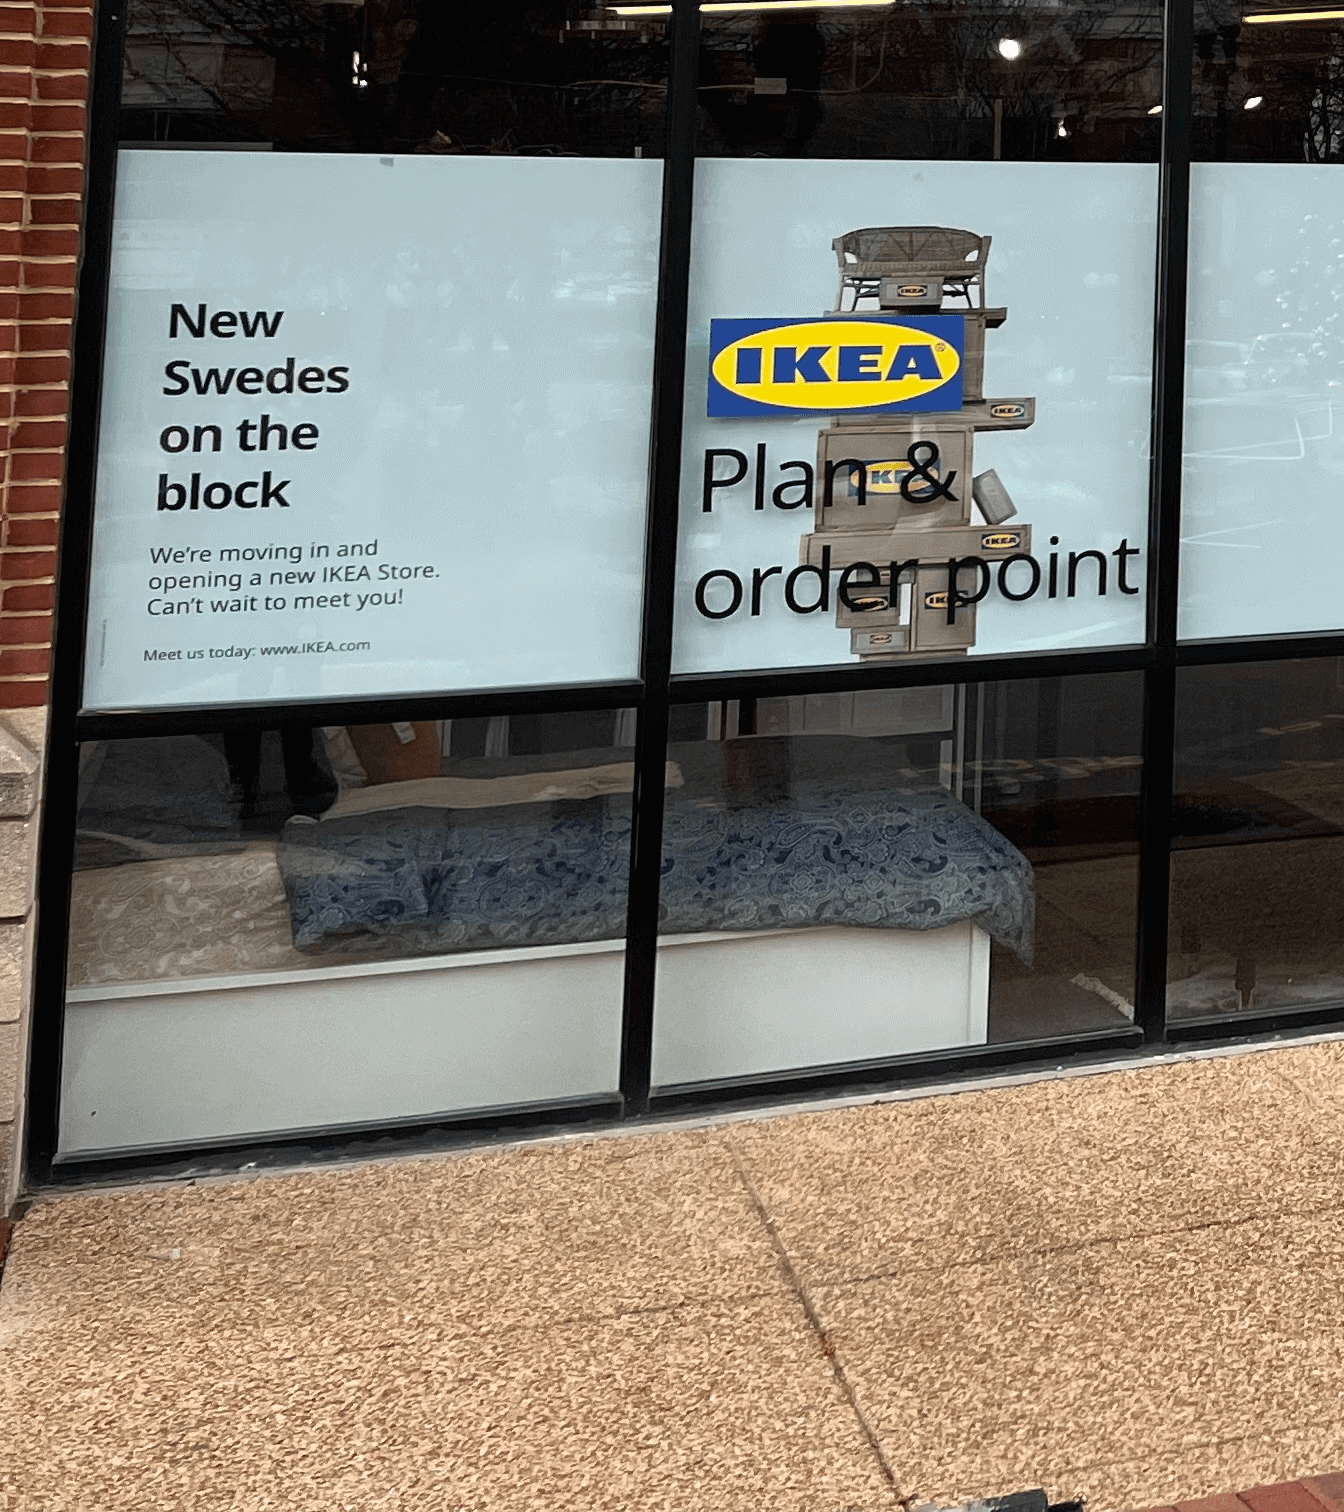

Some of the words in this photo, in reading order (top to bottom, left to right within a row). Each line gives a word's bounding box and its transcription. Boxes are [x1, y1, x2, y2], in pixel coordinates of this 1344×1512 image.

[168, 303, 284, 338] New
[162, 358, 350, 396] Swedes
[736, 344, 944, 385] IKEA
[994, 406, 1022, 414] IKEA
[159, 424, 222, 453] on
[236, 415, 319, 452] the
[157, 471, 290, 511] block
[702, 444, 866, 513] Plan
[902, 440, 959, 504] &
[150, 545, 212, 565] We're
[219, 542, 303, 565] moving
[310, 541, 329, 559] in
[337, 539, 379, 558] and
[985, 536, 1020, 546] IKEA
[148, 568, 243, 593] opening
[249, 571, 262, 587] a
[269, 568, 316, 586] new
[322, 565, 371, 584] IKEA
[378, 562, 441, 581] Store.
[695, 545, 918, 620] order
[947, 536, 1140, 625] point
[146, 596, 204, 617] Can't
[210, 594, 257, 613] wait
[264, 594, 287, 611] to
[294, 591, 351, 610] meet
[356, 588, 403, 612] you!
[143, 647, 183, 661] Meet
[187, 648, 204, 660] us
[208, 643, 256, 663] today:
[260, 640, 371, 658] www.IKEA.com
